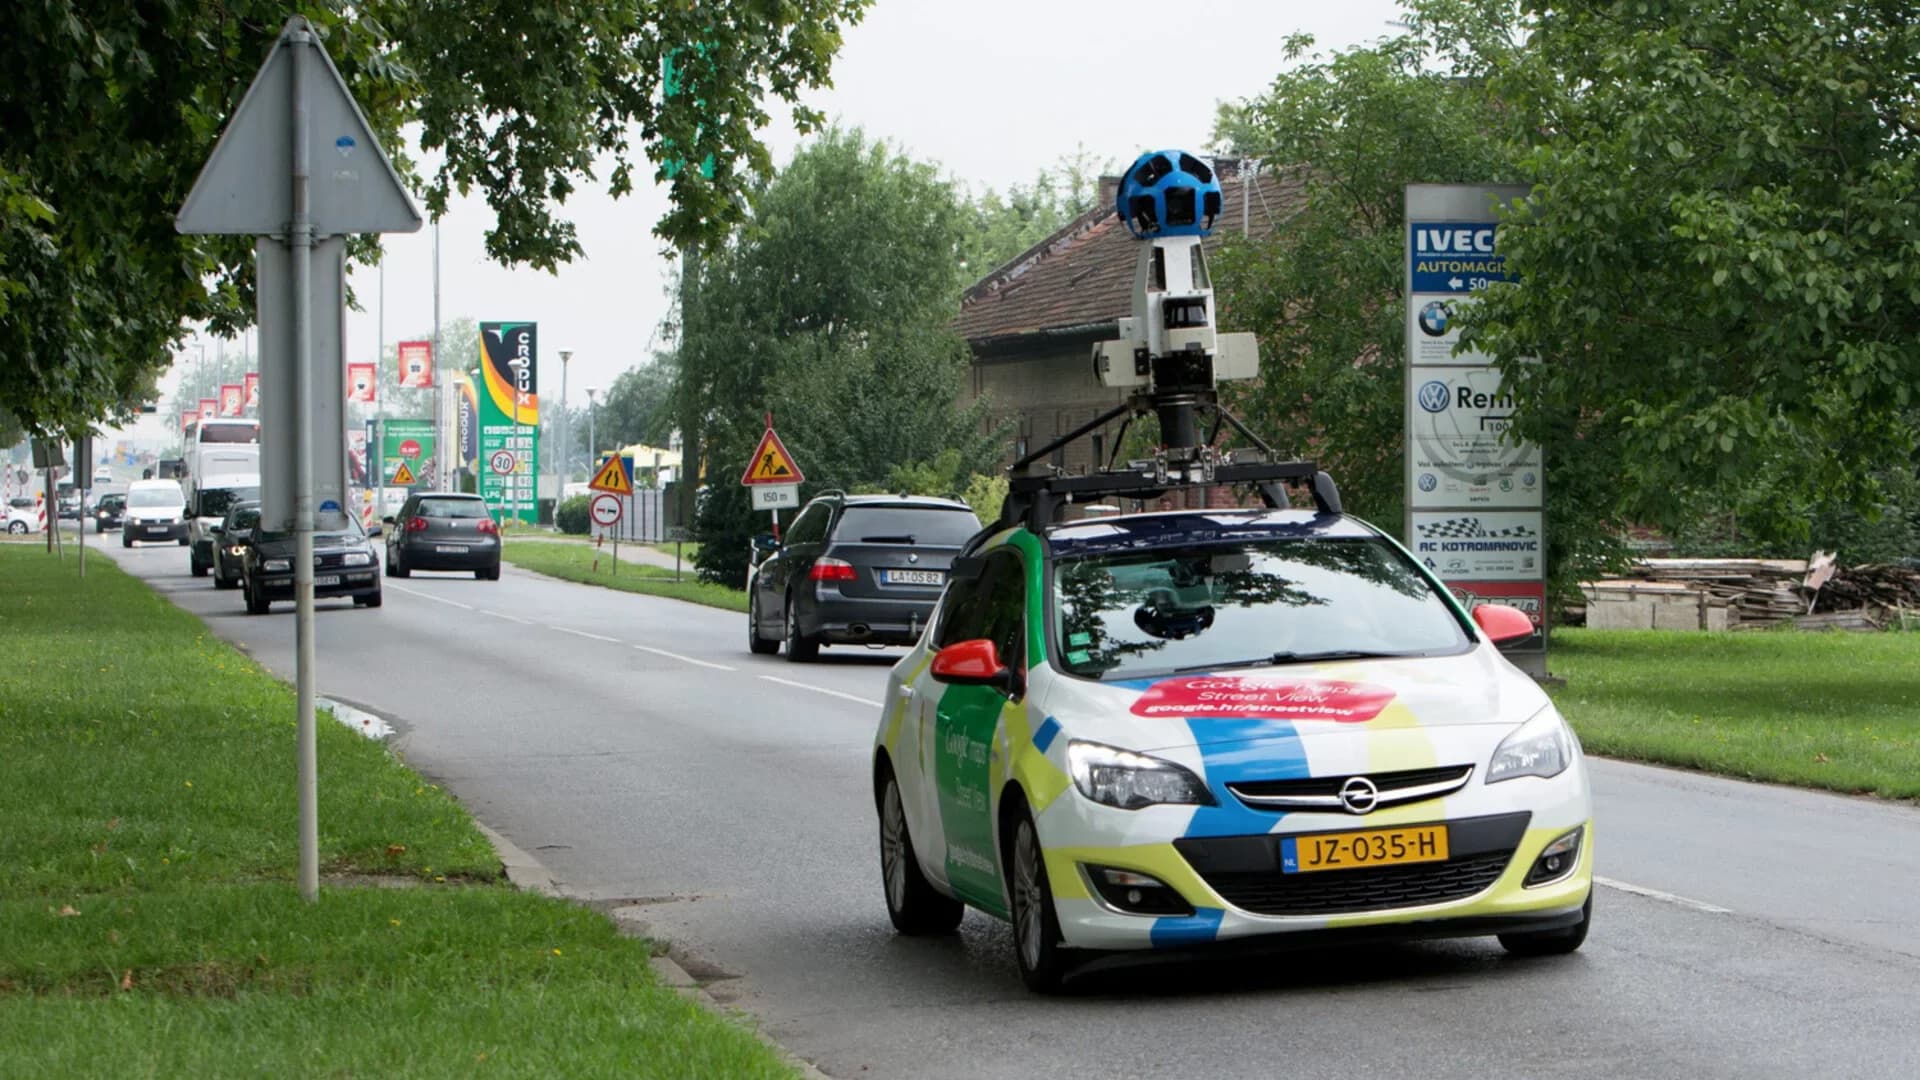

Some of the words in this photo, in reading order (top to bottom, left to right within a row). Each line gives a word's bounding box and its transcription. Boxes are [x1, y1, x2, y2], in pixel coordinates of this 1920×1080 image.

[1417, 229, 1494, 251] IVEC
[518, 332, 530, 405] CRODUX
[1457, 386, 1519, 409] Rem
[461, 401, 470, 452] CRODUX
[495, 456, 510, 470] 30
[763, 492, 778, 502] 150
[780, 493, 788, 501] m
[926, 573, 939, 584] 82
[1197, 691, 1268, 701] Street
[1274, 692, 1329, 704] View
[1145, 703, 1354, 716] google.hr/streetview
[1309, 831, 1436, 866] JZ-035-H
[1284, 858, 1297, 868] NL
